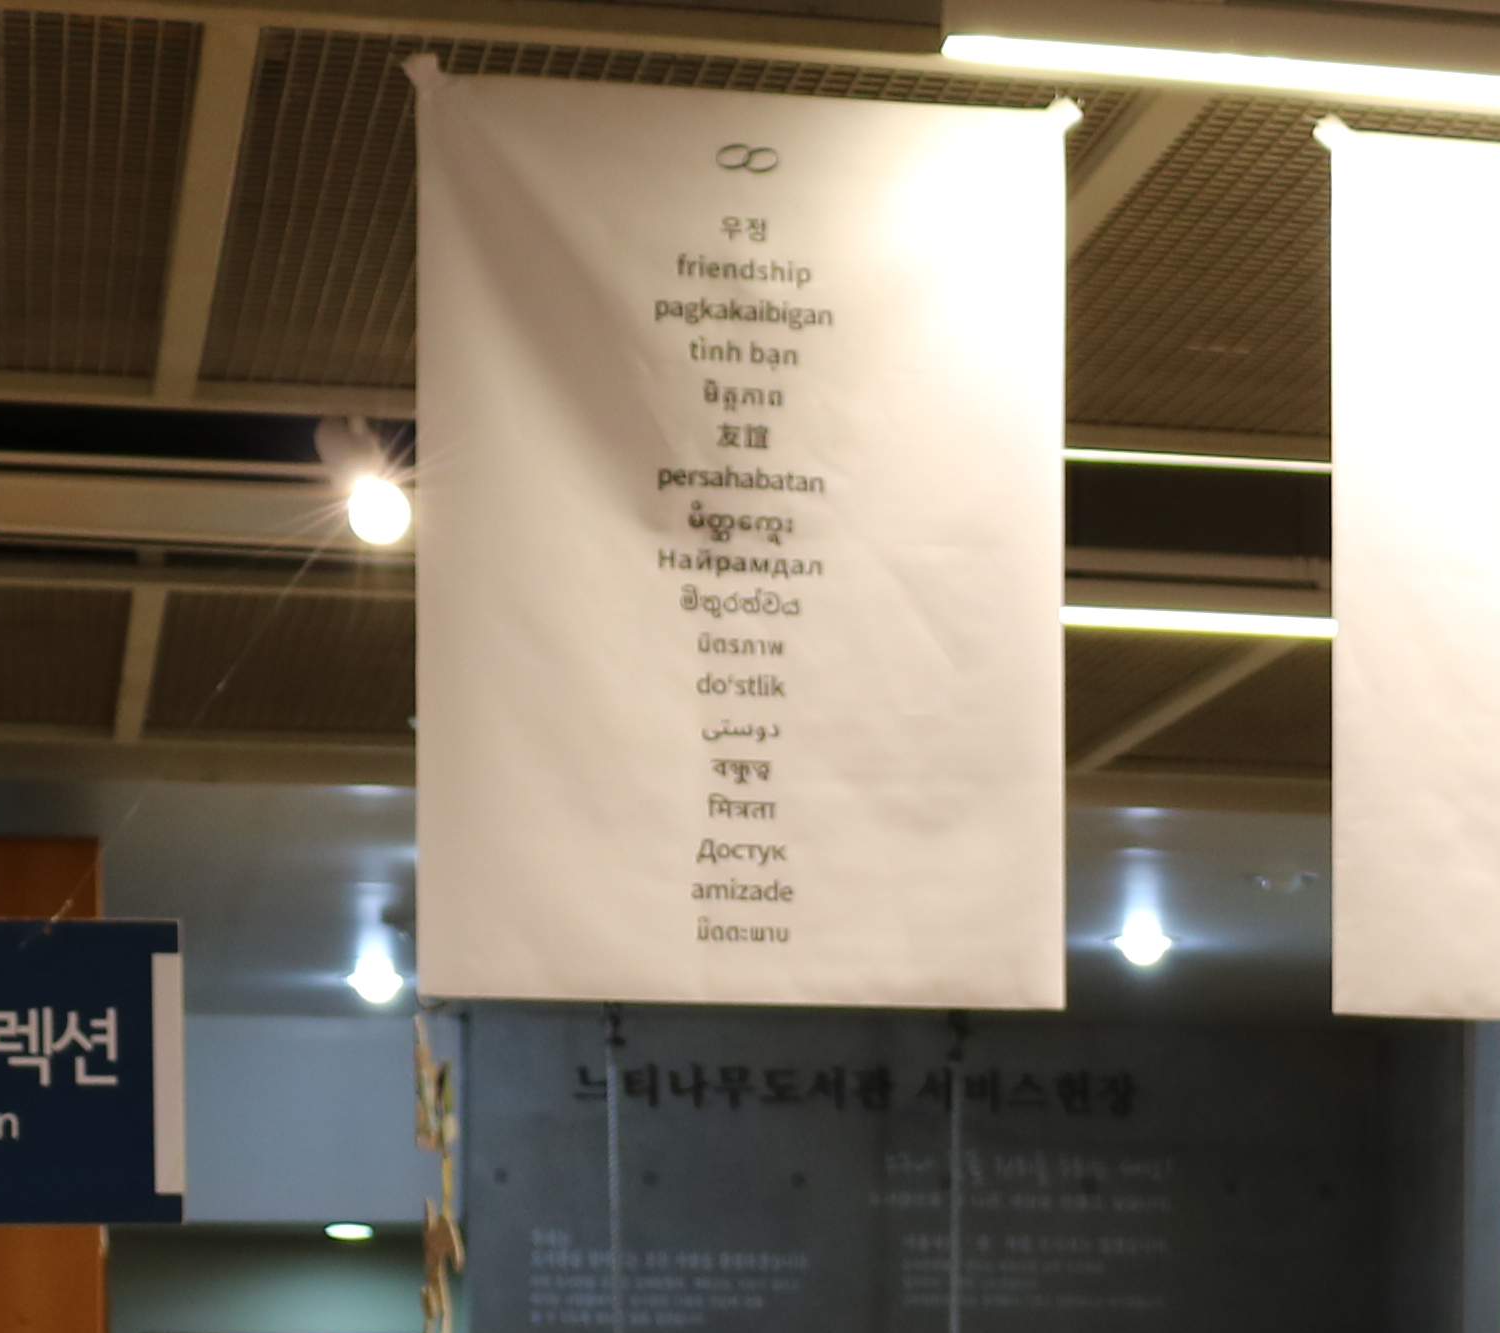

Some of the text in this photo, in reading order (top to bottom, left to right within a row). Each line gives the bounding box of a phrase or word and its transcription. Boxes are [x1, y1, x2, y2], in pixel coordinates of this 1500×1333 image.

[719, 213, 769, 245] 우정
[675, 252, 813, 290] friendship
[652, 292, 835, 330] pagkakaibigan
[688, 337, 800, 372] tình bạn
[656, 463, 827, 495] persahabatan
[657, 548, 824, 580] Найрамдал
[695, 836, 788, 869] Достук
[690, 878, 795, 905] amizade
